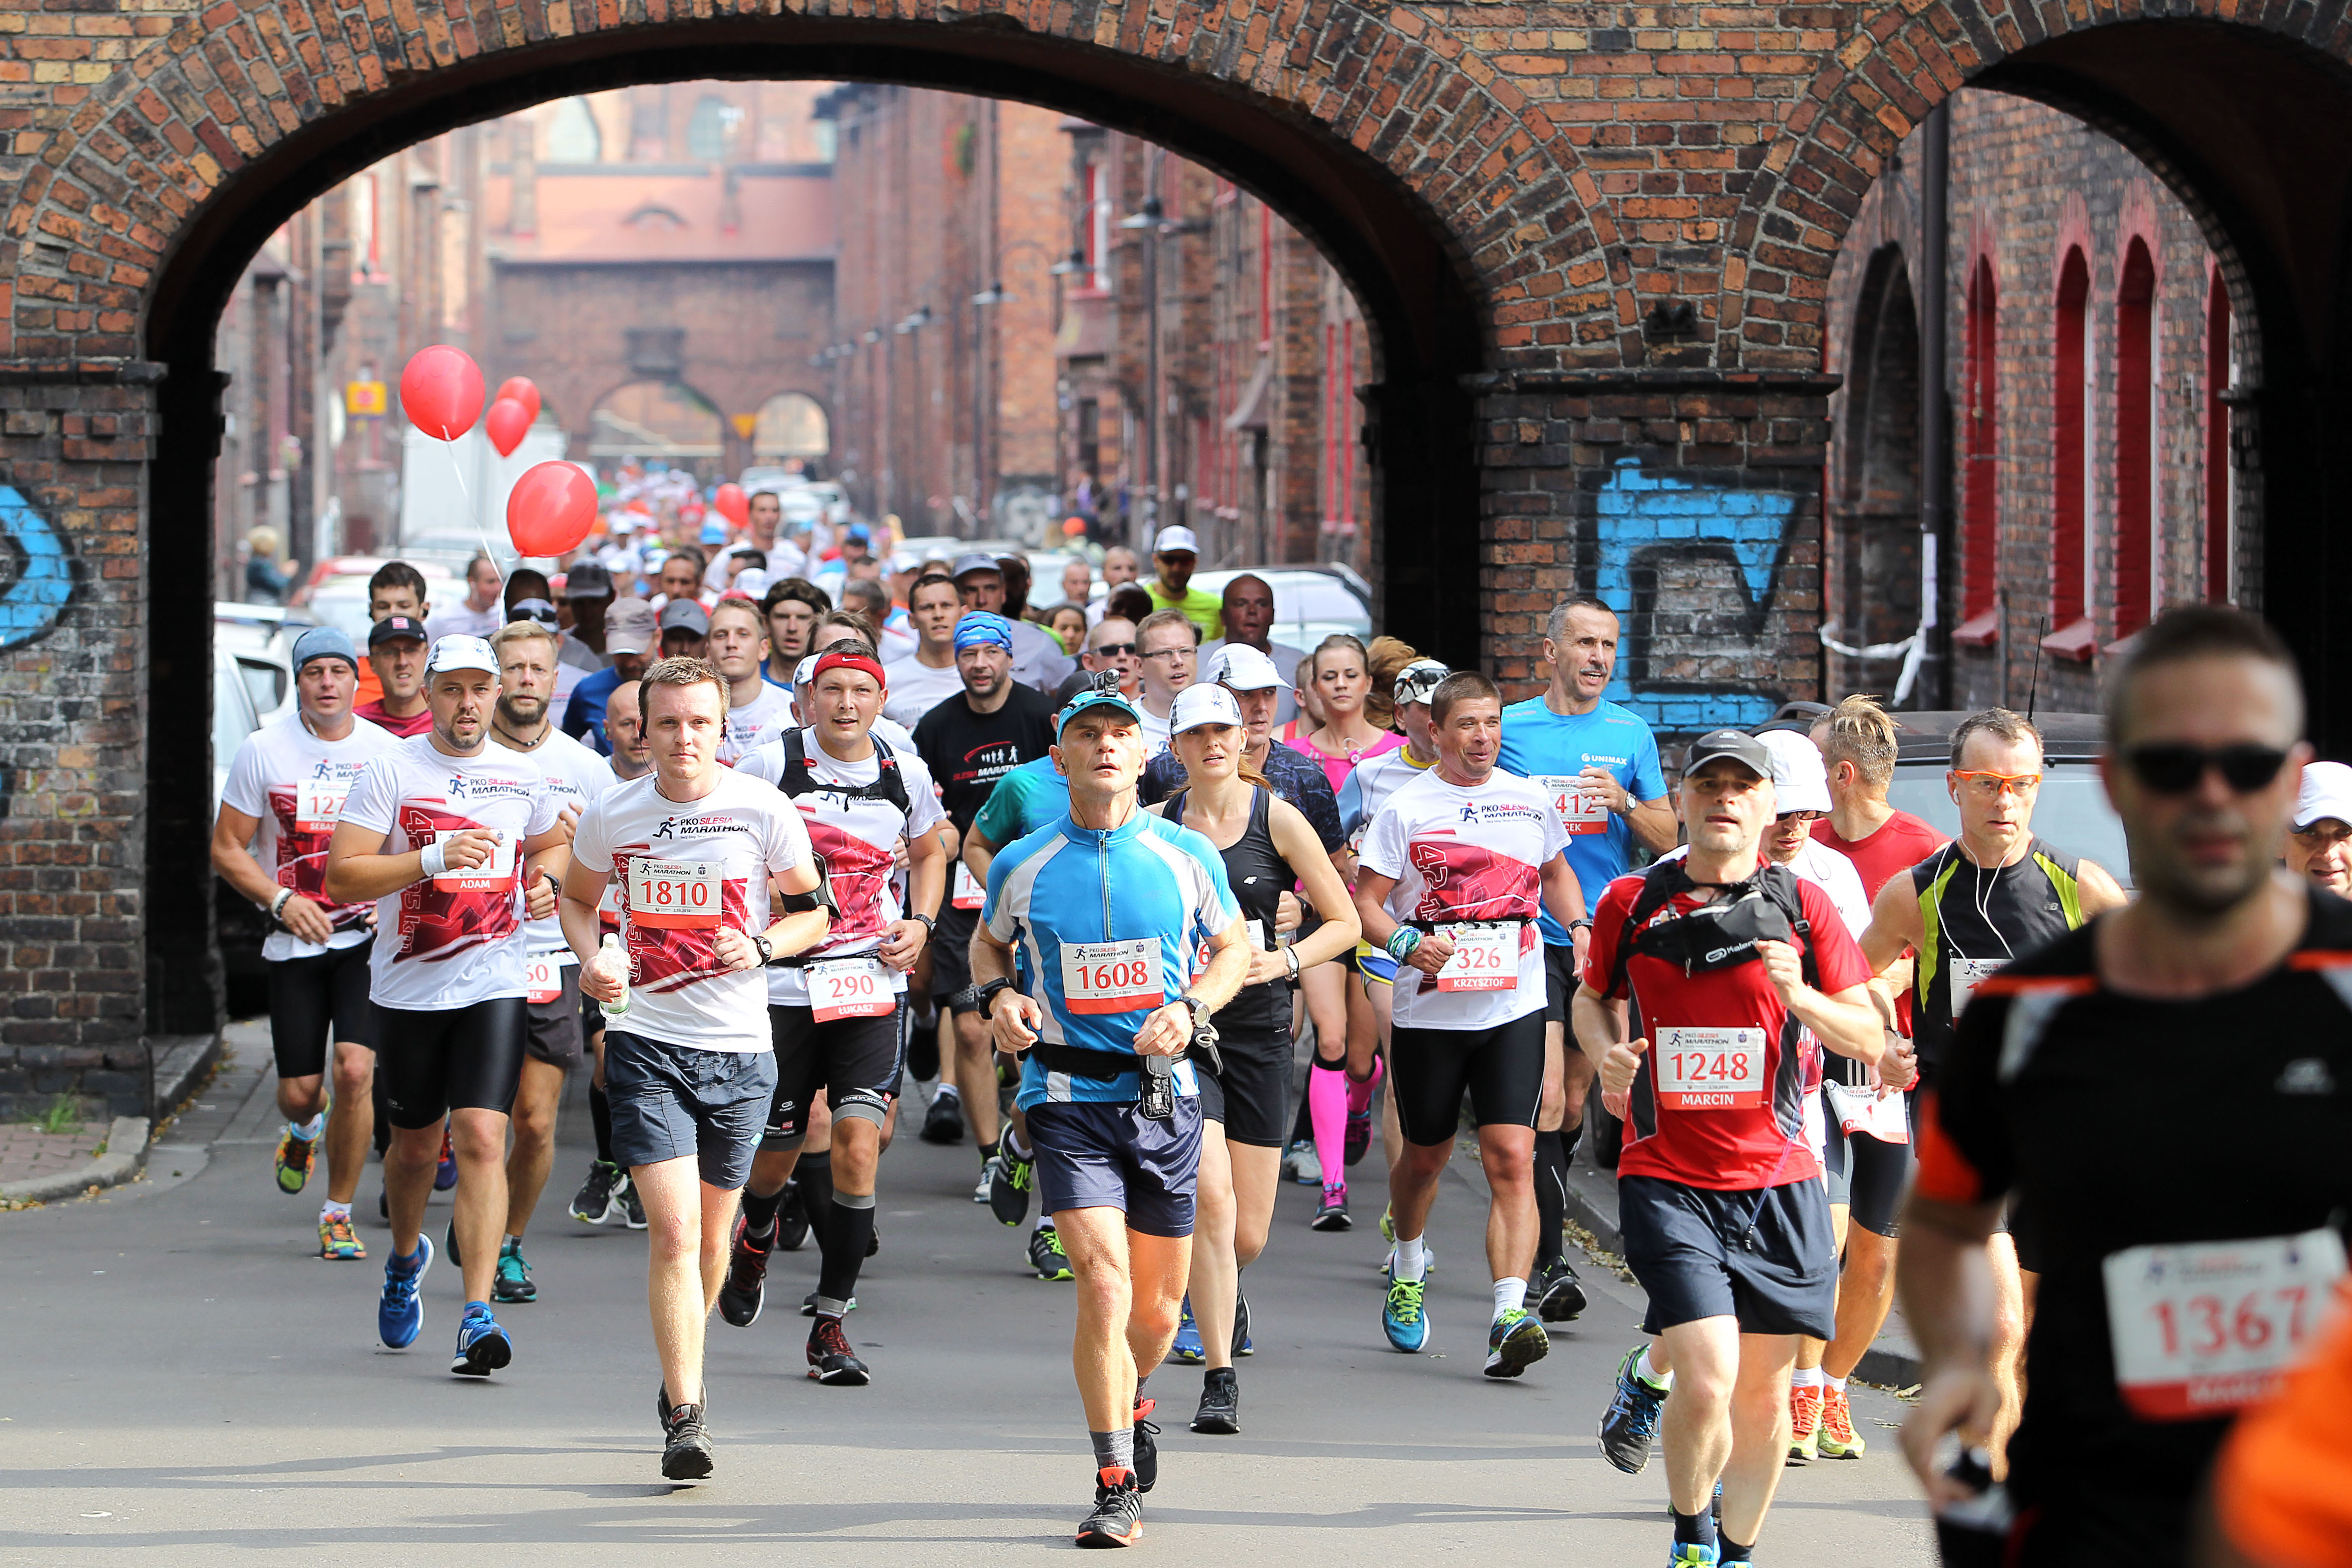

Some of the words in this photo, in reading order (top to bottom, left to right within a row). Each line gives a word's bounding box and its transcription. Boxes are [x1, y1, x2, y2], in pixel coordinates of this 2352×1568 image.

[1591, 755, 1627, 765] UNIMAX
[978, 764, 1025, 776] MARATH
[471, 786, 529, 797] MARATHON
[1484, 811, 1542, 821] MARATHON
[310, 822, 336, 831] SEBAS
[680, 824, 749, 834] MARATHON
[1565, 823, 1582, 831] CEK
[460, 880, 490, 889] ADAM
[641, 881, 707, 906] 1810
[1090, 949, 1128, 958] MARATHON
[1457, 947, 1500, 969] 326
[1076, 961, 1148, 989] 1608
[828, 975, 874, 998] 290
[1454, 978, 1504, 987] KRZYSZTOF
[838, 1004, 874, 1015] ŁUKASZ
[1670, 1053, 1748, 1080] 1248
[1682, 1094, 1734, 1105] MARCIN
[1845, 1120, 1860, 1130] DA
[2145, 1284, 2307, 1358] 1367
